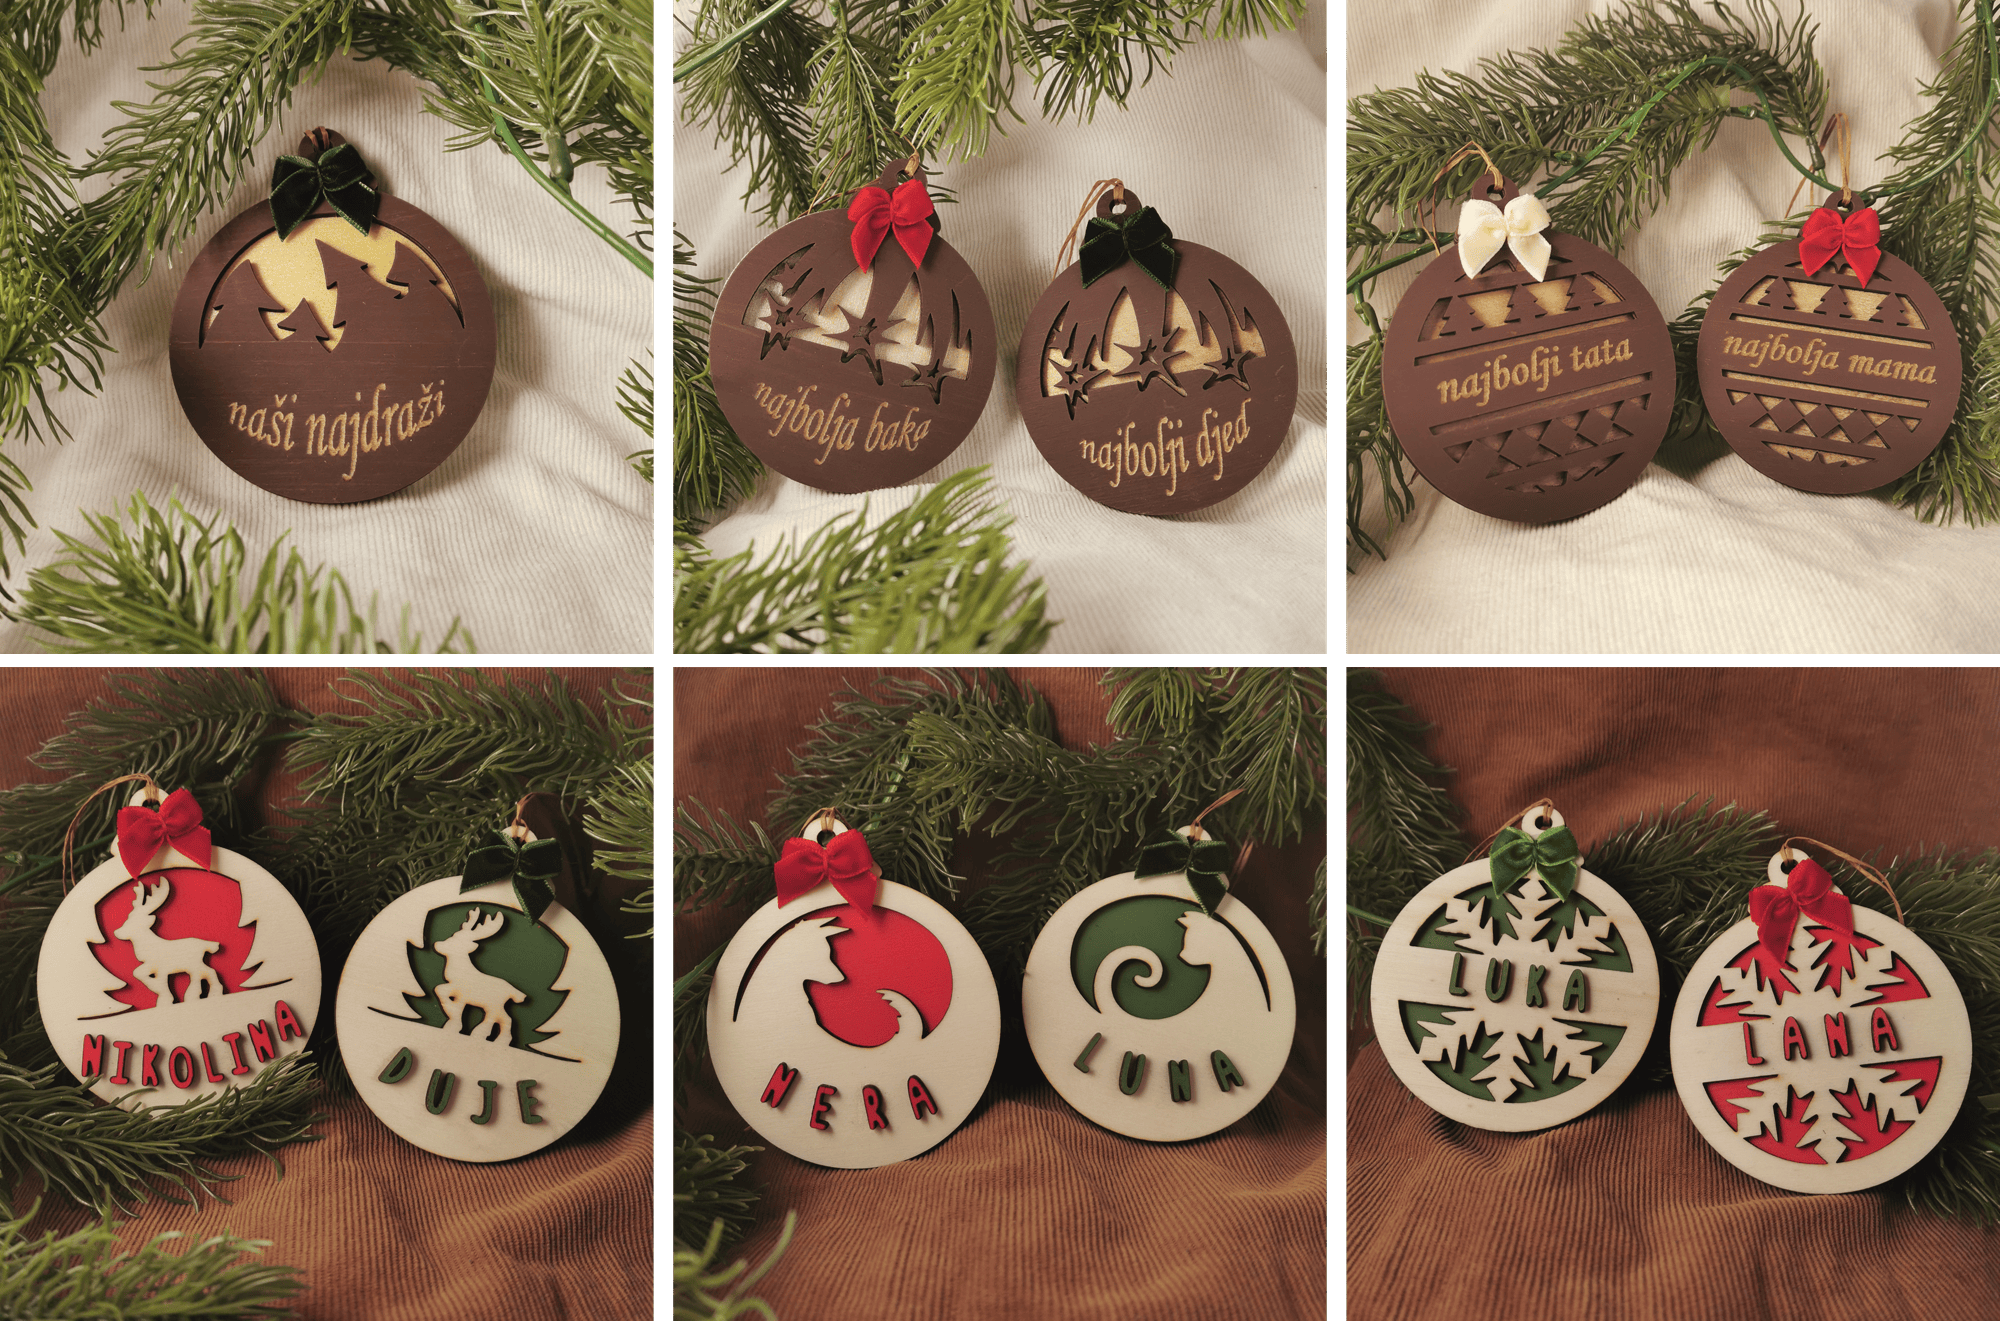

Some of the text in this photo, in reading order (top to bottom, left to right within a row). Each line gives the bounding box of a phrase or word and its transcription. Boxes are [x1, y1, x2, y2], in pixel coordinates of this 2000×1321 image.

[1436, 338, 1634, 408] najbolji tata
[1722, 333, 1937, 385] najbolja mama
[228, 379, 446, 481] naši najdraži
[754, 382, 932, 466] najbolja baka
[1079, 397, 1252, 497] najbolji djed
[1449, 952, 1586, 1013] LUKA
[82, 1000, 302, 1090] NIKOLINA
[1073, 1032, 1244, 1103] LUNA
[1743, 1007, 1898, 1065] LANA
[378, 1046, 543, 1125] DUJE
[760, 1061, 938, 1130] NERA
